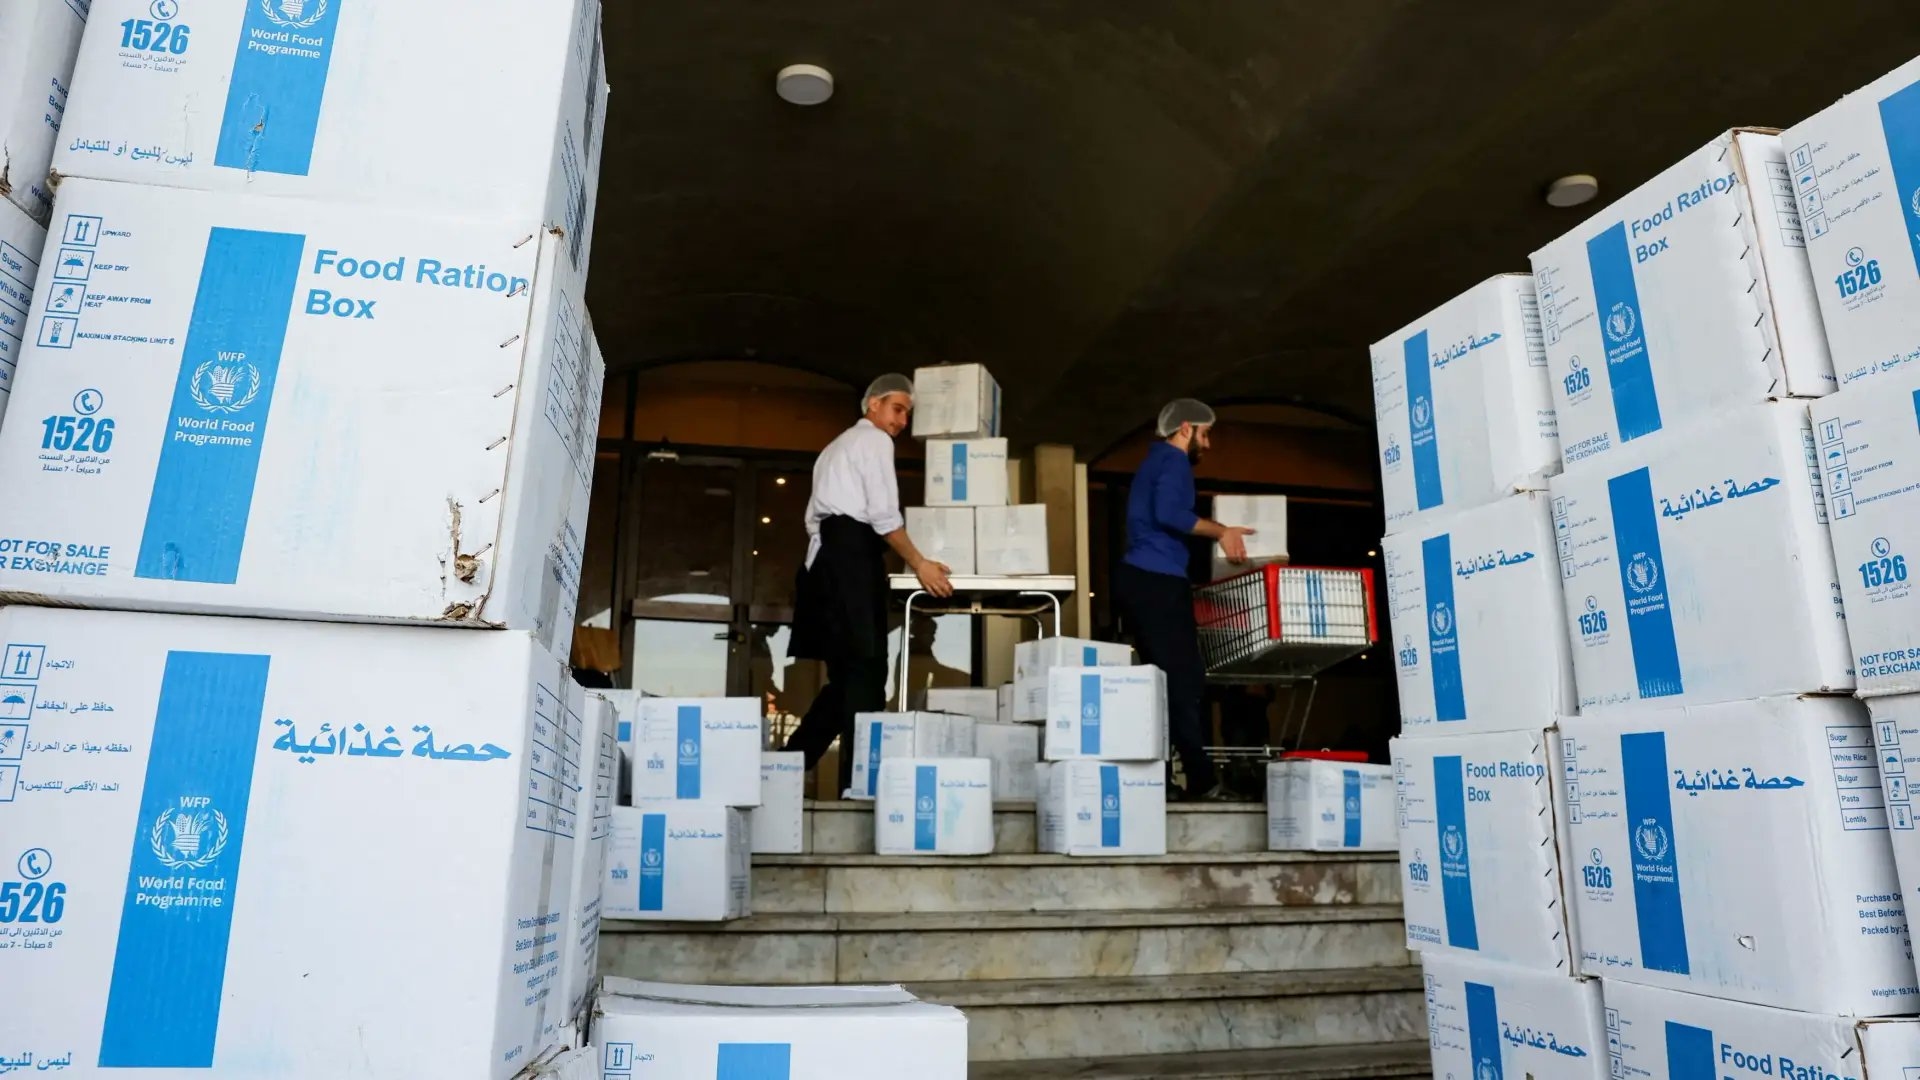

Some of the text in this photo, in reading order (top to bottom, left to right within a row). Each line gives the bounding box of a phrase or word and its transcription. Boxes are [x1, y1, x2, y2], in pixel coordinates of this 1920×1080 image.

[121, 18, 190, 54] 1526
[251, 28, 323, 47] World Food
[248, 40, 320, 59] Programme
[69, 138, 110, 152] للتبادل
[1631, 202, 1674, 239] Food
[101, 230, 132, 238] UPWARD
[1635, 236, 1670, 264] Box
[2, 252, 23, 274] Sugar
[94, 263, 129, 272] KEEP DRY
[313, 249, 529, 297] Food Ration
[1834, 259, 1882, 299] 1526
[86, 293, 152, 305] KEEP AWAY FROM
[305, 288, 377, 320] Box
[77, 332, 112, 340] MAXIMUM
[113, 334, 148, 343] STACKING
[1432, 331, 1502, 370] حصة غذائية
[1609, 336, 1641, 357] World Food
[218, 351, 246, 362] WFP
[1610, 347, 1643, 365] Programme
[1563, 367, 1590, 396] 1526
[1842, 366, 1868, 384] للتبادل
[178, 416, 255, 433] World Food
[41, 415, 115, 454] 1526
[175, 430, 252, 447] Programme
[1565, 432, 1609, 456] NOT FOR SALE
[1846, 446, 1859, 455] KEEP
[1384, 444, 1401, 467] 1526
[1566, 441, 1611, 465] OR EXCHANGE
[1850, 460, 1893, 477] KEEP AWAY FROM
[1660, 475, 1781, 521] حصة غذائية
[25, 540, 61, 558] FOR
[65, 545, 111, 560] SALE
[1632, 551, 1646, 561] WFP
[11, 556, 109, 577] EXCHANGE
[1455, 549, 1535, 580] حصة غذائية
[1858, 554, 1908, 589] 1526
[1628, 592, 1664, 607] World Food
[1630, 602, 1665, 616] Programme
[1577, 610, 1608, 636] 1526
[45, 659, 75, 669] الاتجاه
[1399, 647, 1418, 668] 1526
[1859, 650, 1906, 666] NOT FOR
[1861, 667, 1877, 678] OR
[36, 701, 115, 714] حافظ على الجفاف
[25, 740, 60, 753] الحرارة
[272, 718, 512, 764] حصة غذائية
[1830, 733, 1848, 743] Sugar
[63, 743, 78, 753] عن
[104, 743, 132, 753] احفظه
[1833, 753, 1868, 762] White Rice
[1466, 761, 1545, 779] Food Ration
[64, 780, 120, 794] الحد الأقصى
[1673, 767, 1806, 797] حصة غذائية
[1837, 774, 1859, 784] Bulgur
[180, 796, 211, 809] WFP
[1468, 786, 1491, 802] Box
[1841, 795, 1860, 803] Pasta
[1642, 818, 1656, 826] WFP
[1845, 815, 1867, 823] Lentils
[1408, 862, 1429, 882] 1526
[1635, 863, 1673, 873] World Food
[138, 876, 226, 891] World Food
[1582, 866, 1613, 889] 1526
[1637, 873, 1674, 883] Programme
[136, 892, 222, 909] Programme
[1856, 894, 1892, 904] Purchase
[1859, 910, 1877, 919] Best
[1861, 924, 1903, 935] Packed by:
[1871, 987, 1898, 997] Weight:
[1501, 1021, 1547, 1050] غذائية
[1547, 1032, 1588, 1058] حصة
[37, 1051, 72, 1070] ليس
[1720, 1042, 1857, 1080] Food Rati
